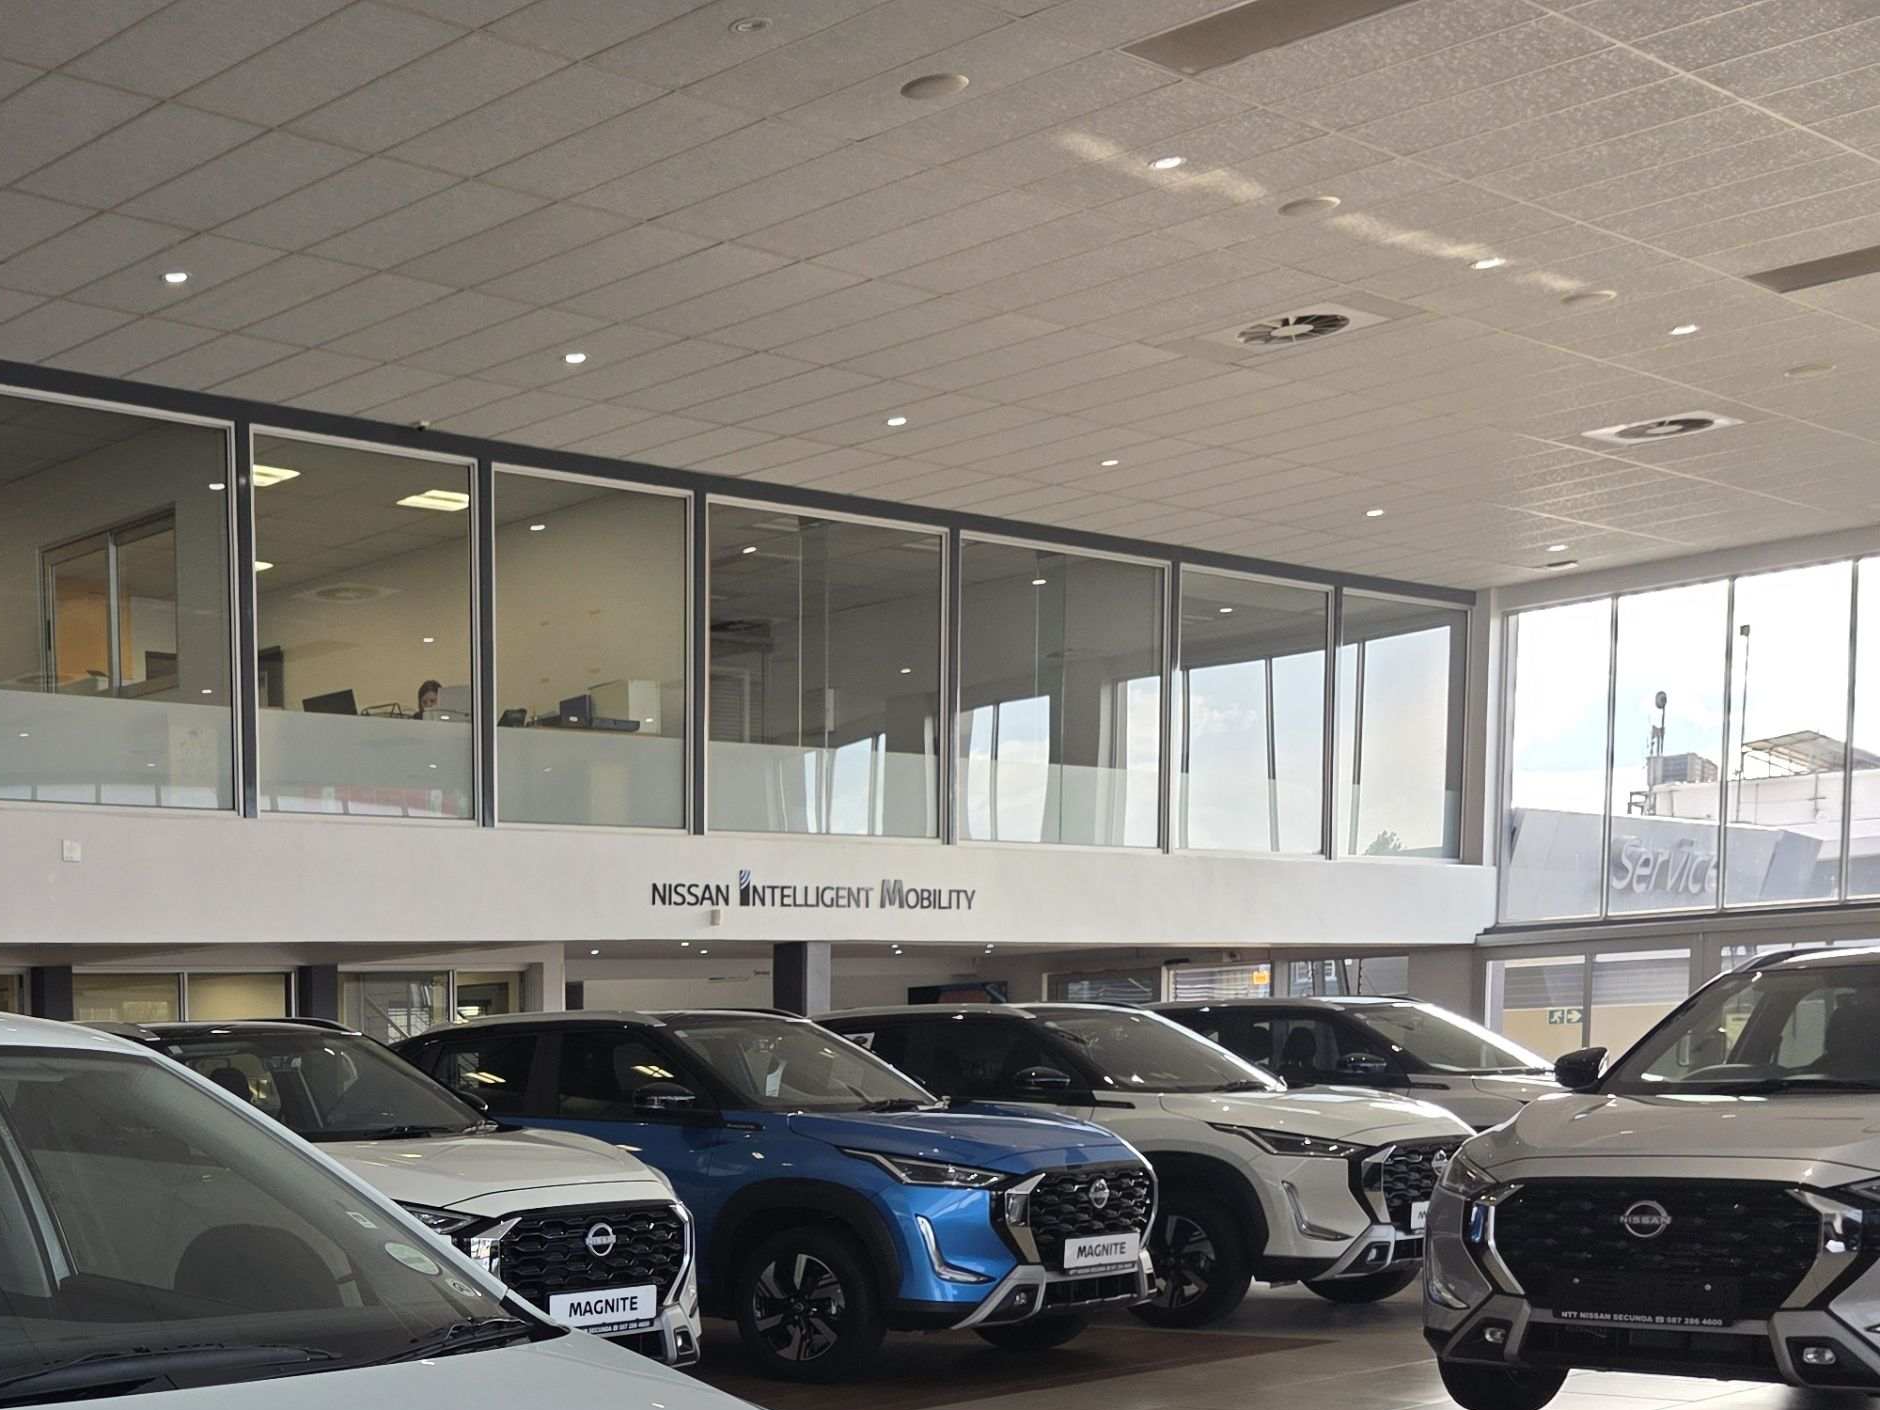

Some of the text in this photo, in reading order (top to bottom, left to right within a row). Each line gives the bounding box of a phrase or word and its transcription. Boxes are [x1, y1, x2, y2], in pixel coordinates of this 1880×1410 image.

[651, 869, 976, 910] NISSAN INTELLIGENT MOBILITY
[1076, 1241, 1127, 1260] MAGNITE
[568, 1295, 639, 1318] MAGNITE
